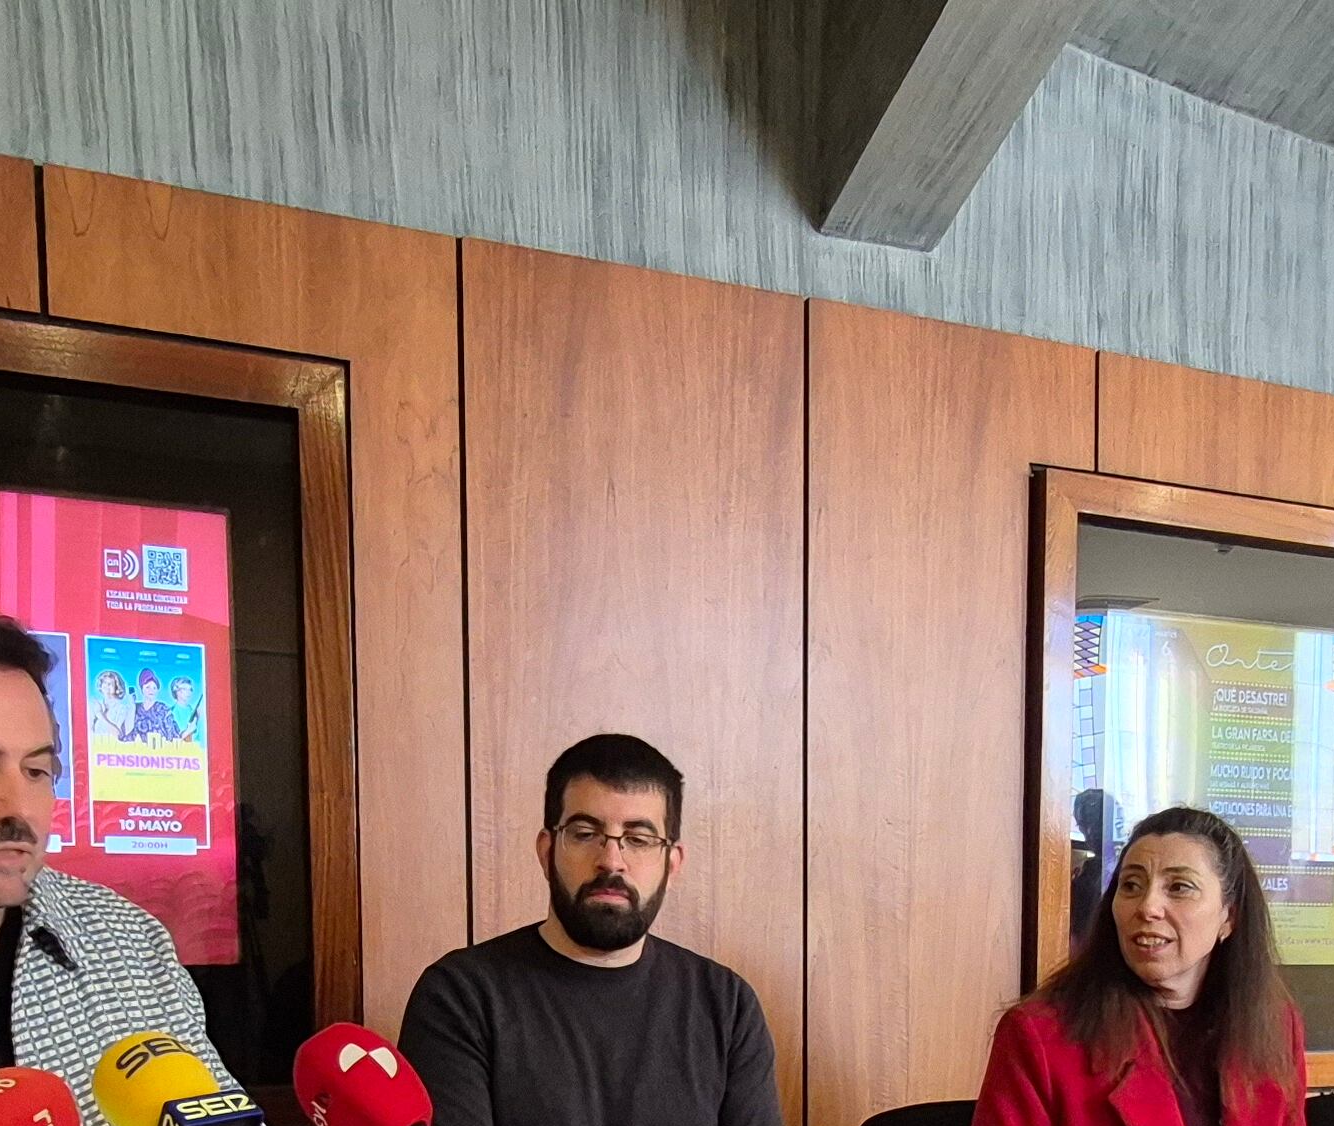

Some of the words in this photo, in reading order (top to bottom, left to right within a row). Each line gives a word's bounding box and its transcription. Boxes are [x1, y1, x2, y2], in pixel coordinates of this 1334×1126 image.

[1211, 725, 1221, 739] LA
[1224, 726, 1251, 740] GRAN
[96, 753, 201, 771] PENSIONISTAS
[127, 806, 173, 818] SÁBADO
[119, 818, 140, 831] 10
[142, 820, 182, 833] MAYO
[176, 1092, 259, 1121] SER
